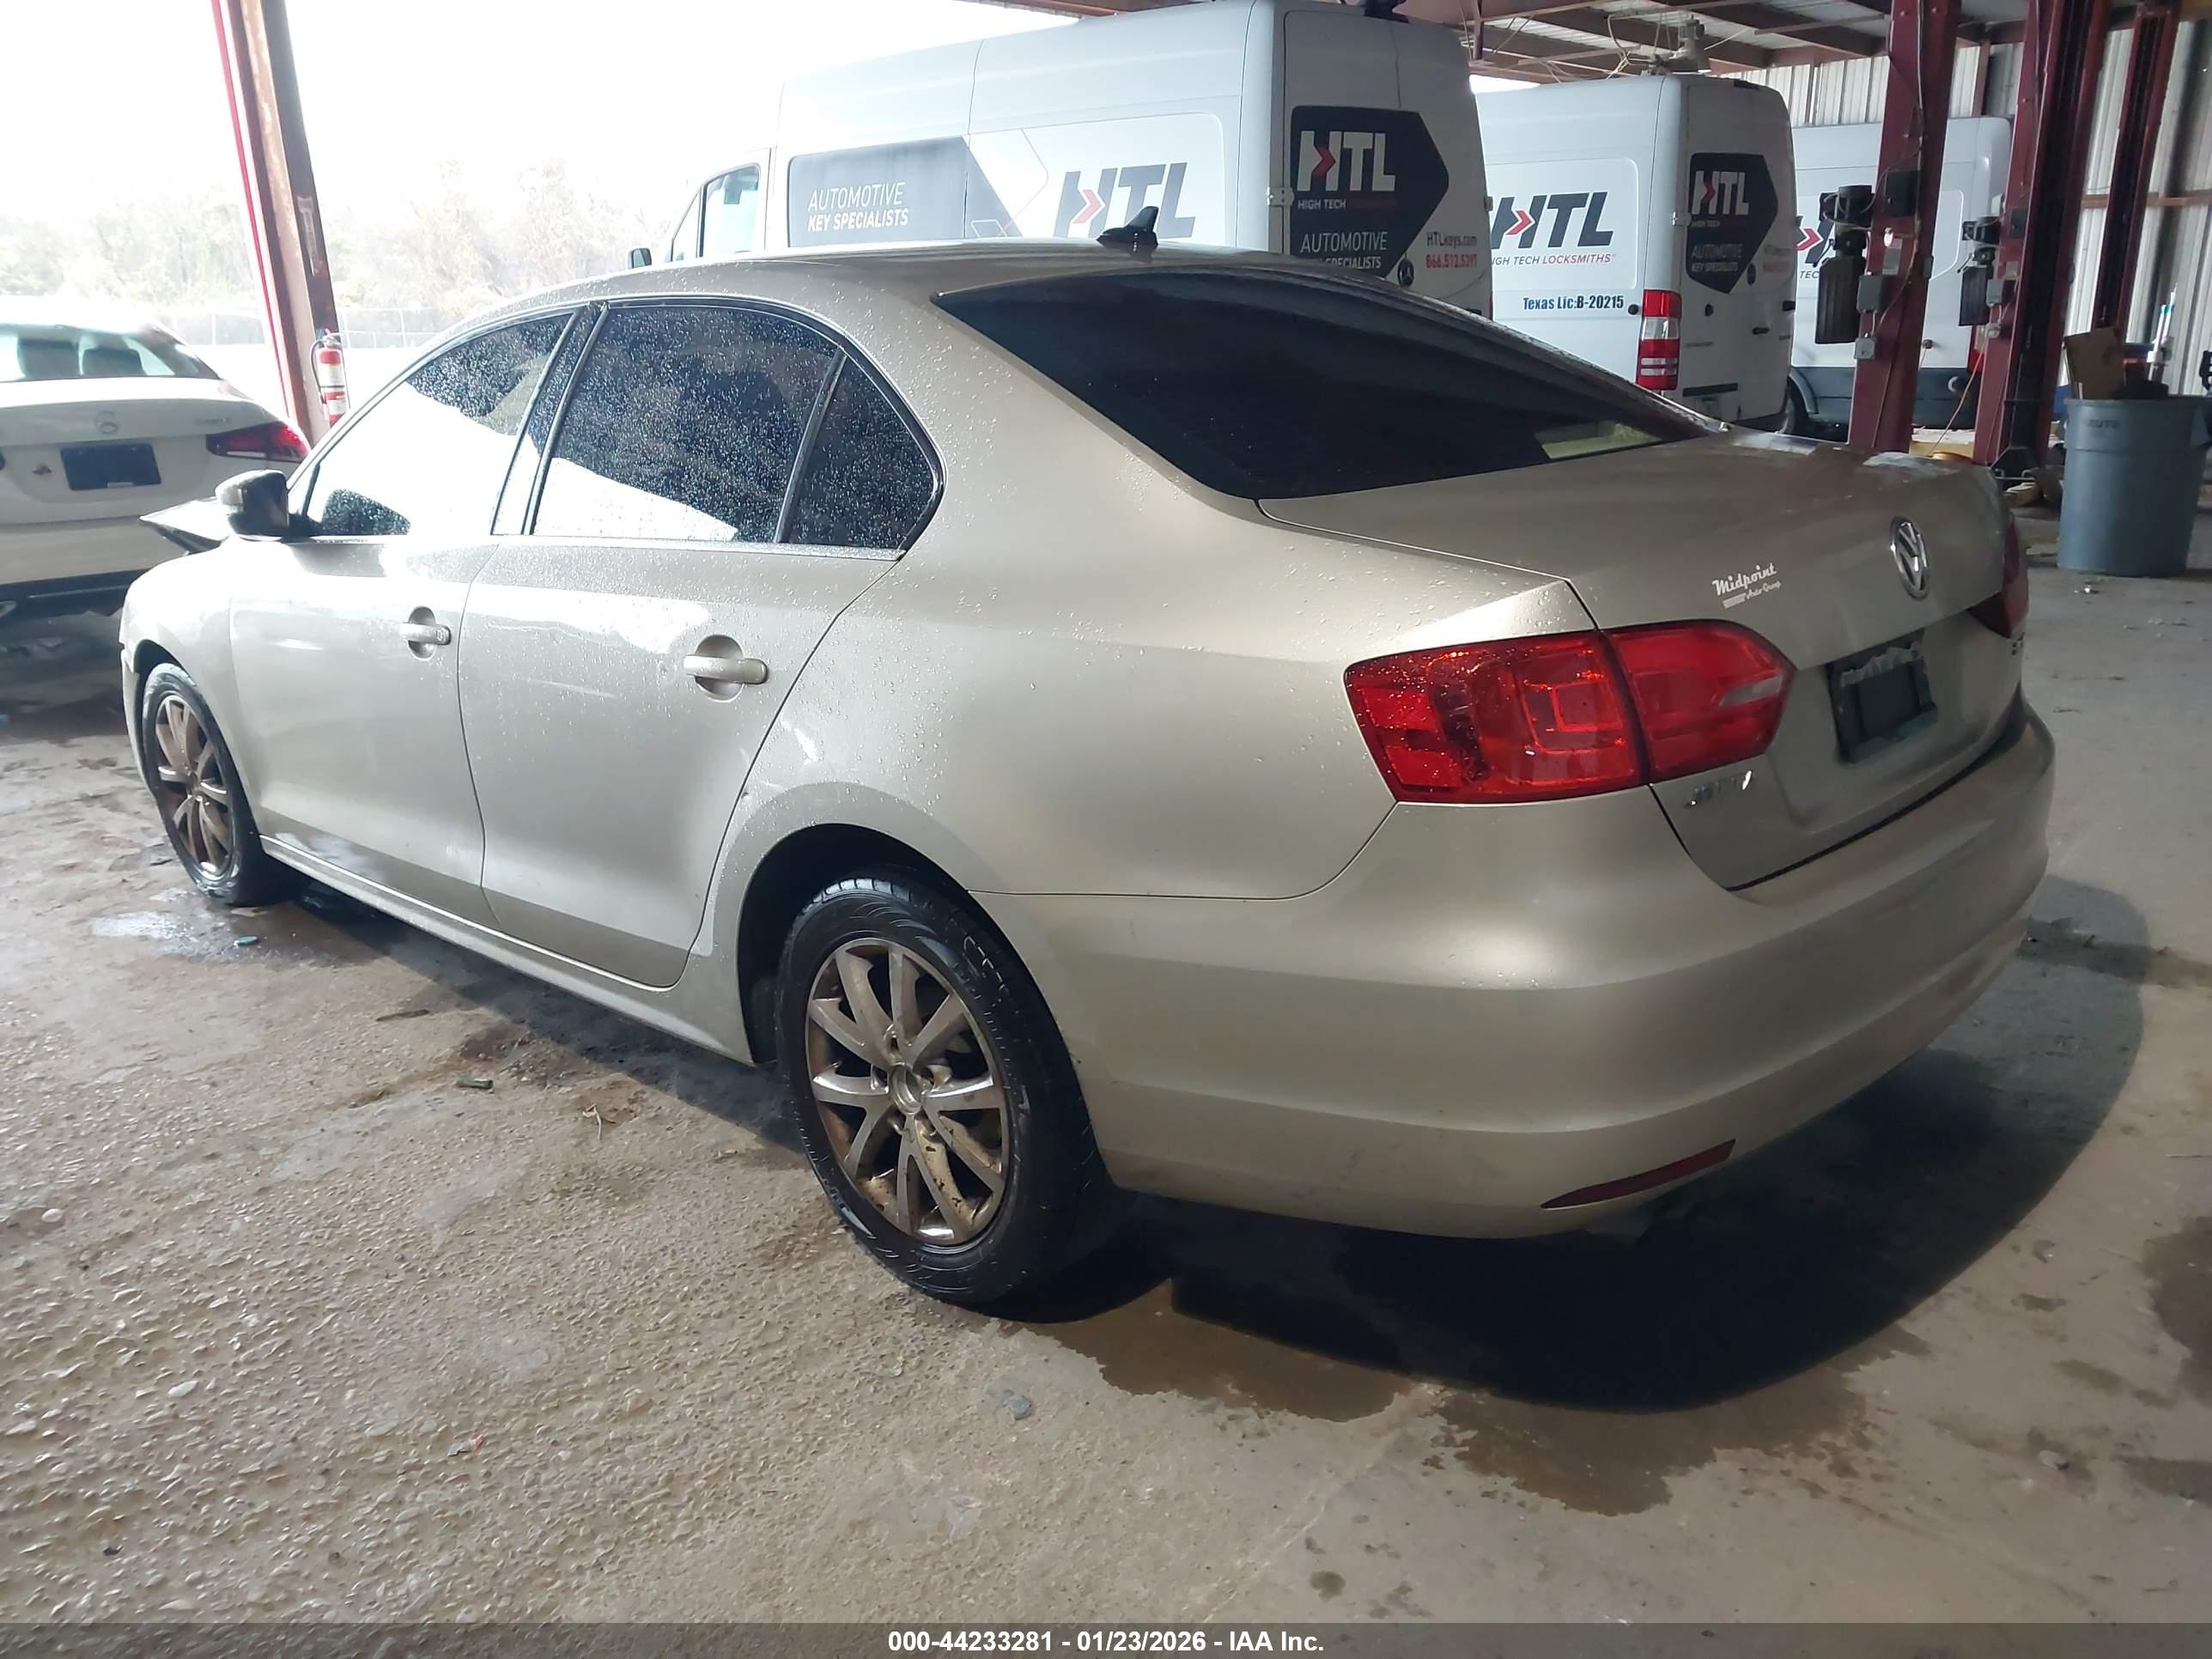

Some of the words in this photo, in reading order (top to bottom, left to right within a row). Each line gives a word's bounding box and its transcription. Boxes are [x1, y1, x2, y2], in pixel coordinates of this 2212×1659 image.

[1297, 131, 1395, 191] HTL
[807, 181, 906, 212] AUTOMOTIVE
[1054, 162, 1195, 239] HTL
[1297, 198, 1322, 210] HIGH
[1323, 198, 1346, 209] TECH
[1692, 170, 1749, 215] HTL
[807, 214, 832, 232] KEY
[833, 208, 908, 230] SPECIALISTS
[1491, 191, 1613, 249] HTL
[1299, 231, 1388, 253] AUTOMOTIVE
[1542, 253, 1611, 264] LOCKSMITHS
[1523, 297, 1554, 310] Texas
[1711, 562, 1777, 596] Midpoint
